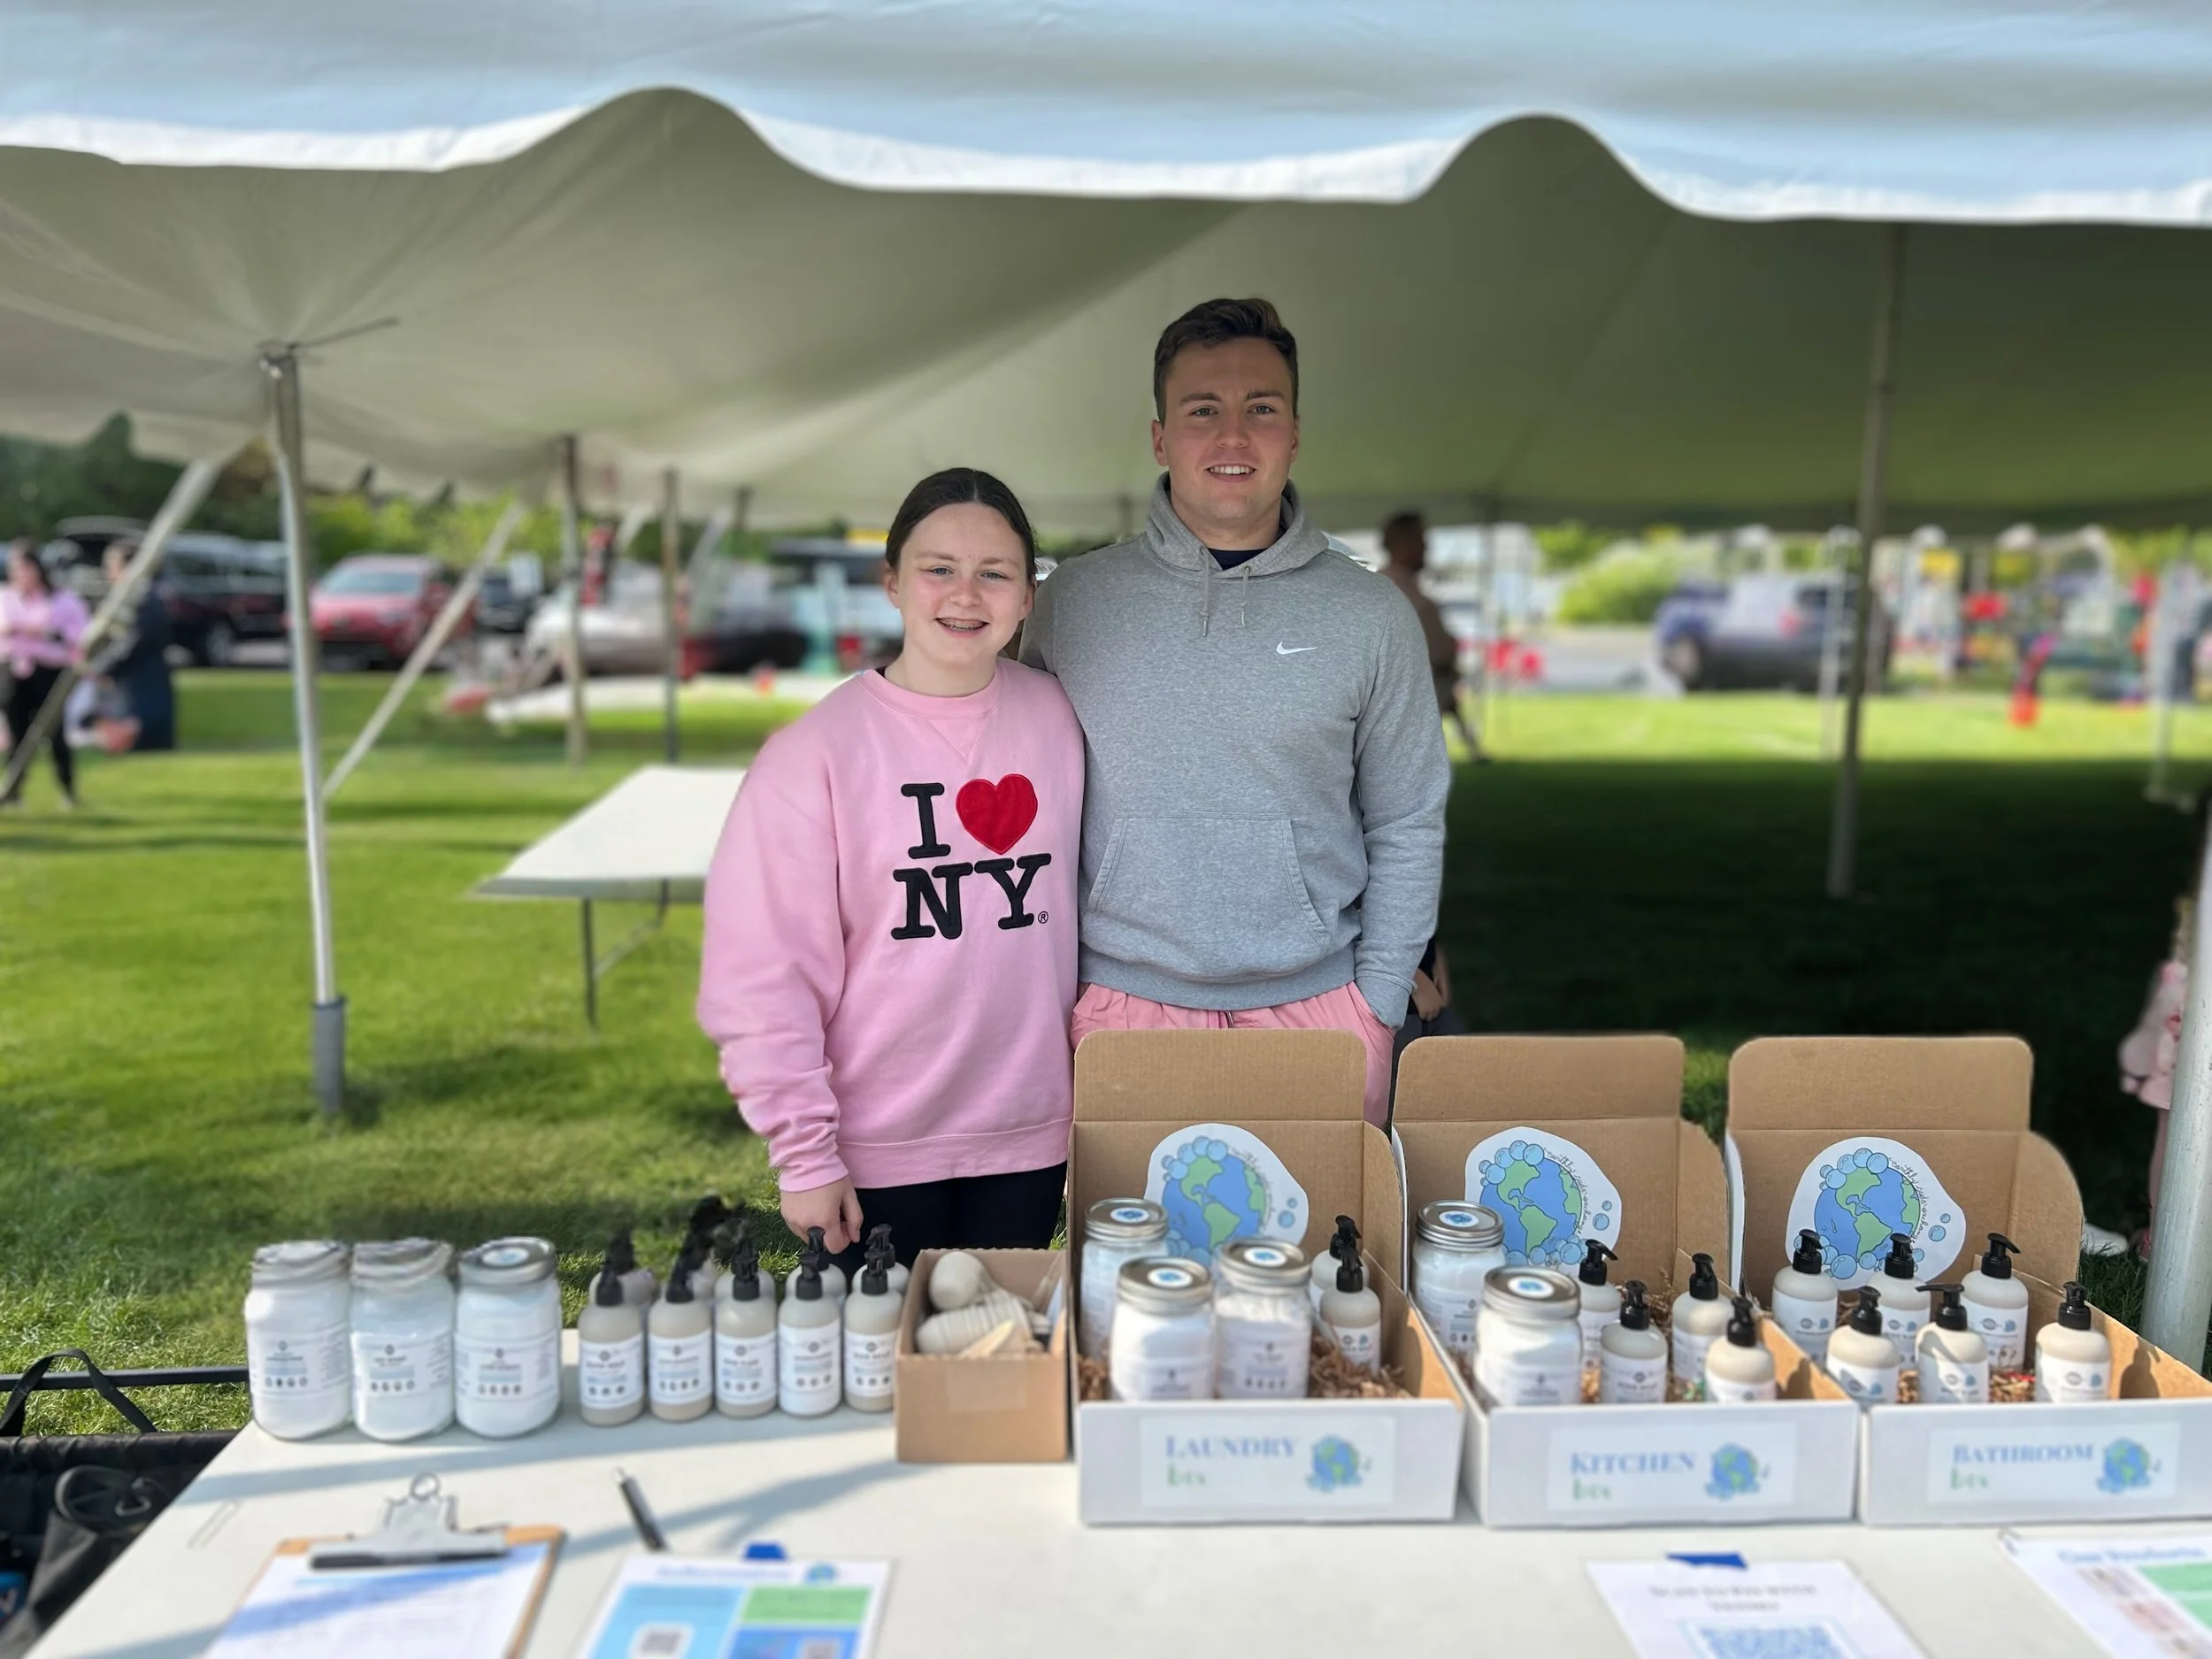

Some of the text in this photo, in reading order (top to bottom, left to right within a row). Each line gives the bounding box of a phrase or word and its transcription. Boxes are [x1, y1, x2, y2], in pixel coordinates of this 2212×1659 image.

[901, 782, 951, 859] I
[1166, 1434, 1299, 1459] LAUNDRY
[1952, 1443, 2093, 1464] BATHROOM
[1571, 1450, 1698, 1475] KITCHEN
